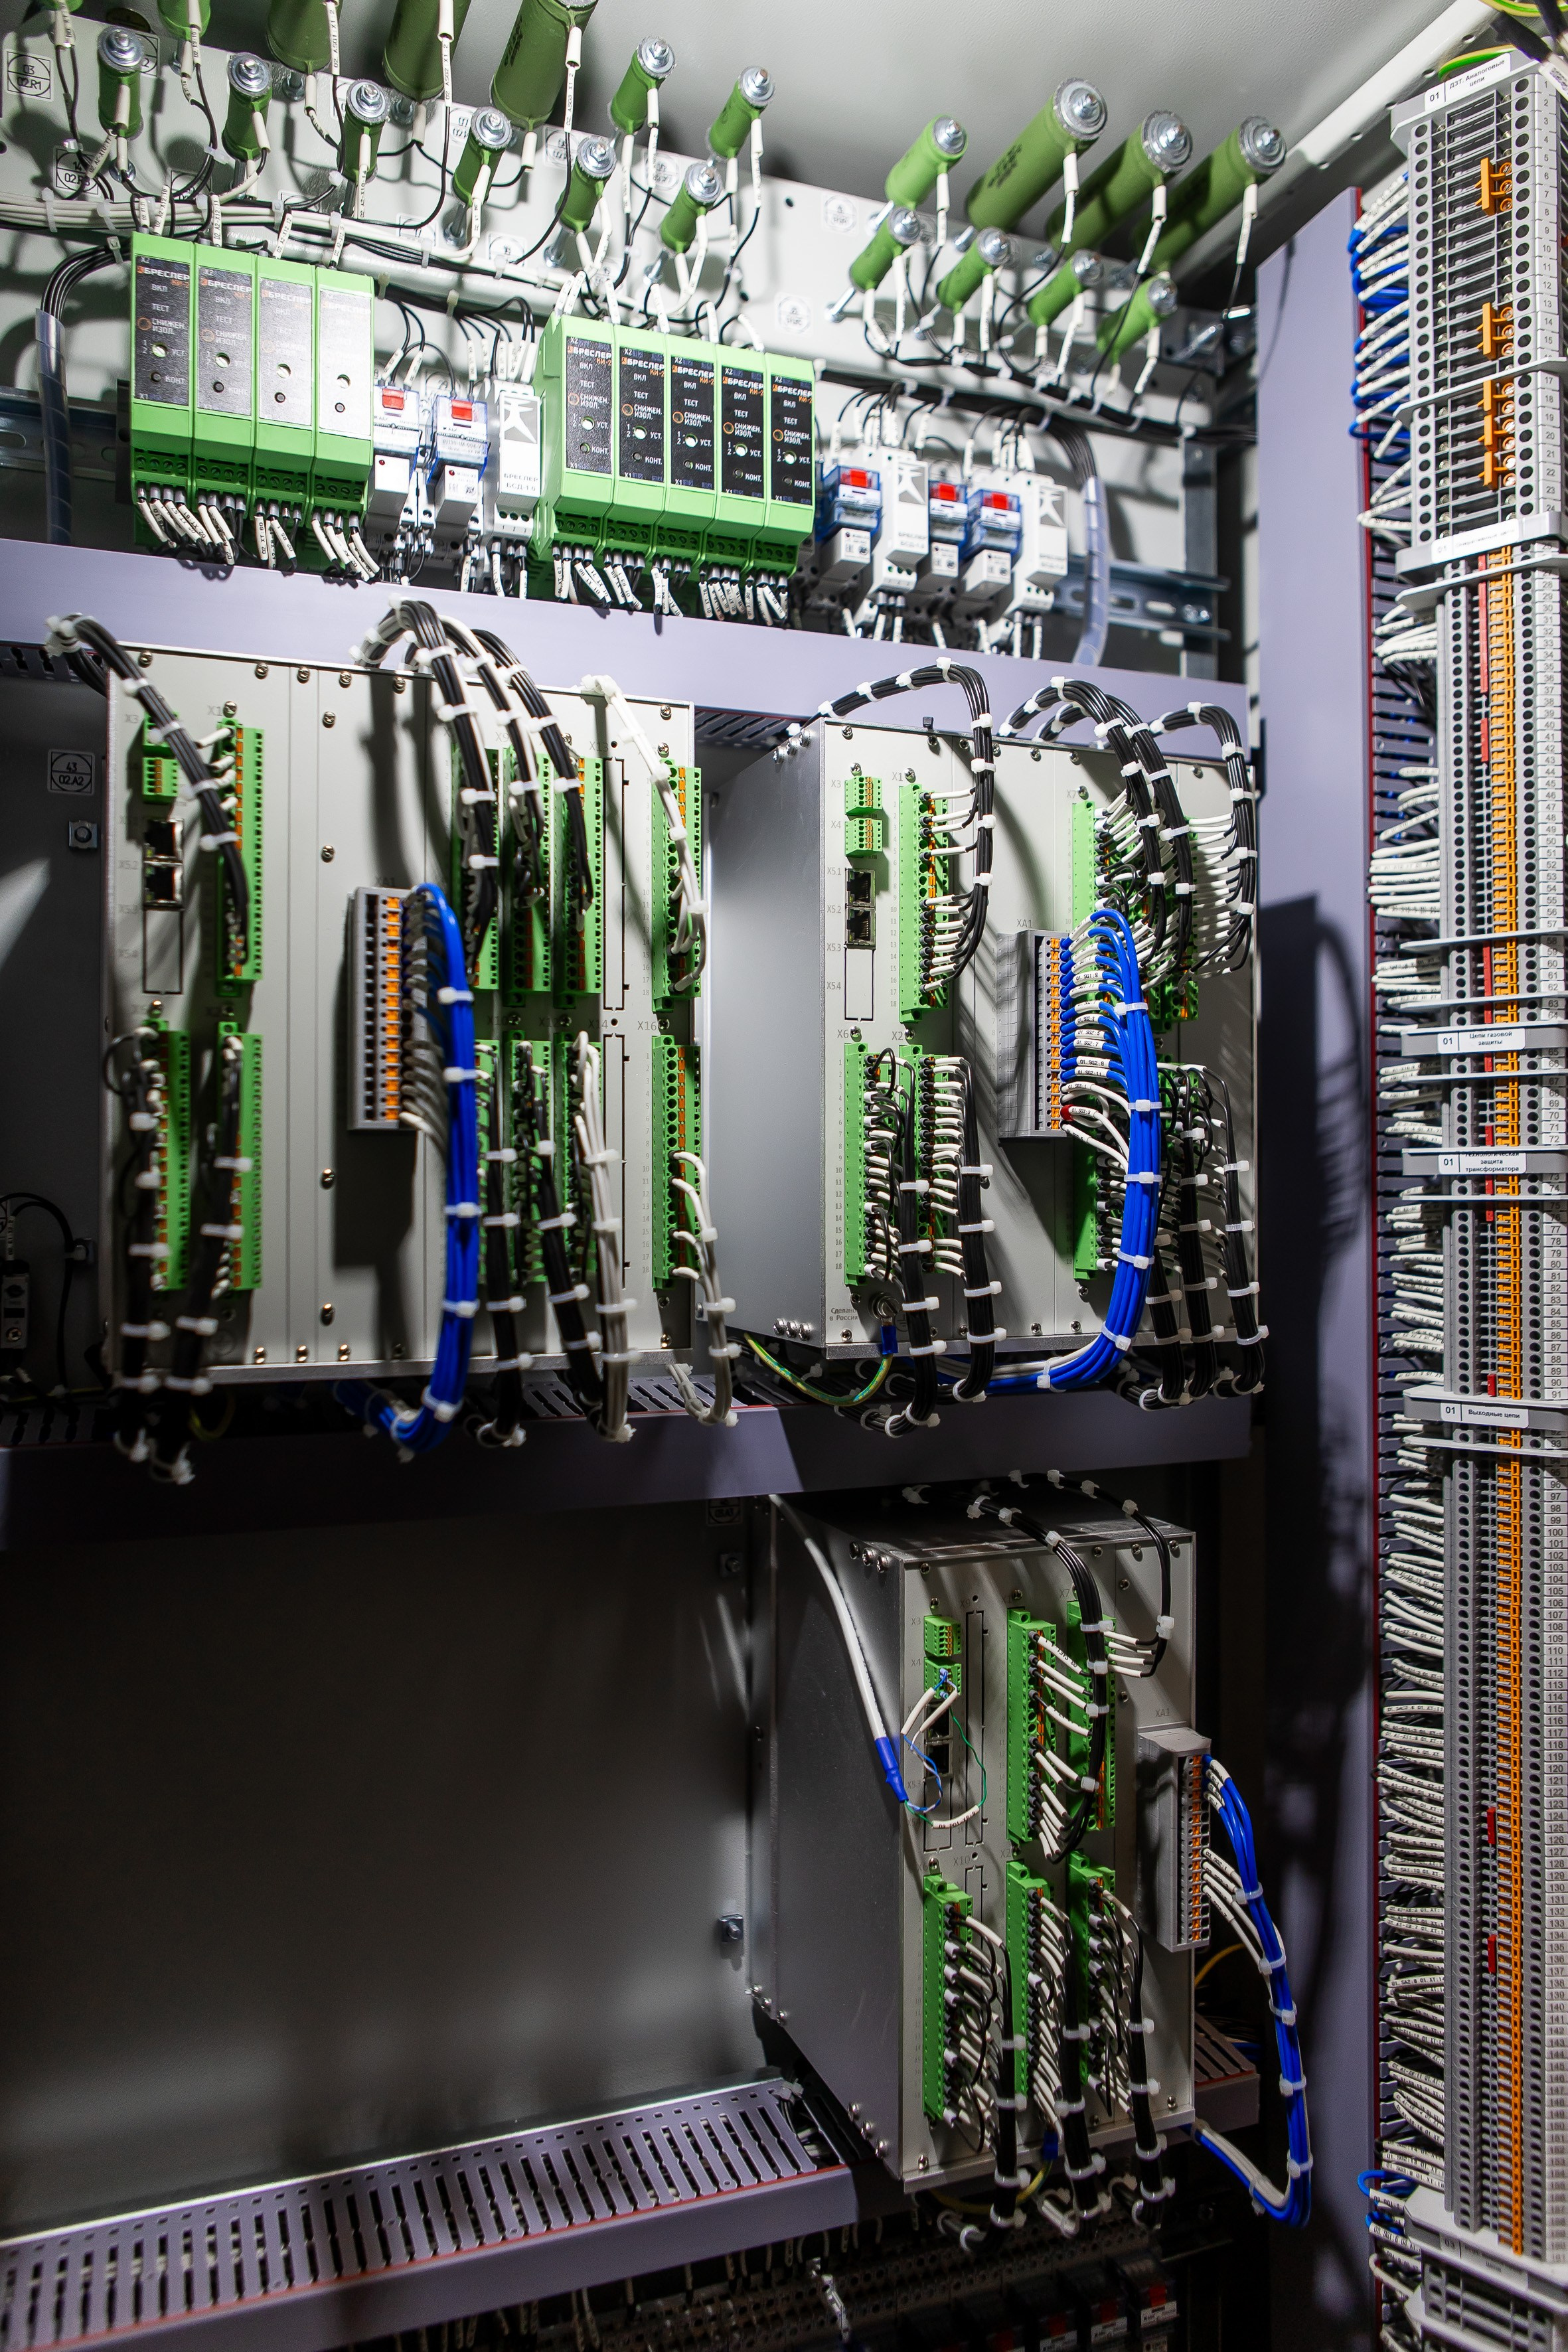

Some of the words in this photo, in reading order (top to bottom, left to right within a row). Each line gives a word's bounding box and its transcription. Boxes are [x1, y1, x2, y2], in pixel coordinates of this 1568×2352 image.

[23, 64, 35, 74] 03
[1450, 78, 1464, 89] ДЗТ.
[1466, 60, 1505, 82] Аналоговые
[1470, 76, 1485, 87] цепи
[1429, 92, 1439, 102] 01
[1543, 98, 1549, 107] 2
[1543, 117, 1549, 125] 3
[1543, 135, 1549, 144] 4
[1543, 153, 1549, 162] 5
[1543, 190, 1549, 198] 7
[1544, 208, 1549, 216] 8
[1541, 244, 1551, 253] 10
[1542, 262, 1551, 272] 11
[1542, 281, 1551, 290] 12
[1543, 299, 1552, 309] 13
[1543, 317, 1553, 326] 14
[1543, 335, 1553, 345] 15
[573, 347, 612, 358] БРЕСЛЕР
[627, 358, 665, 370] БРЕСЛЕР
[677, 366, 714, 378] БРЕСЛЕР
[633, 373, 647, 382] ВКЛ
[1544, 376, 1553, 385] 17
[580, 380, 595, 388] ТЕСТ
[683, 381, 696, 390] ВКЛ
[728, 378, 763, 390] БРЕСЛЕР
[777, 386, 813, 398] БРЕСЛЕР
[684, 398, 698, 407] ТЕСТ
[1545, 394, 1554, 404] 18
[783, 400, 796, 408] ВКЛ
[734, 409, 748, 418] ТЕСТ
[1545, 413, 1554, 422] 19
[783, 417, 798, 426] ТЕСТ
[1545, 431, 1555, 440] 20
[1545, 449, 1555, 458] 21
[1545, 467, 1555, 477] 22
[1545, 485, 1555, 495] 23
[66, 762, 77, 772] 43
[892, 772, 903, 781] X1
[831, 779, 841, 788] X3
[1067, 789, 1077, 799] X7
[1016, 919, 1033, 928] XA1
[637, 1021, 657, 1030] X16
[837, 1030, 849, 1038] X6
[892, 1032, 903, 1040] X2
[1059, 1589, 1070, 1598] X7
[911, 1617, 921, 1626] X3
[1155, 1707, 1170, 1717] XA1
